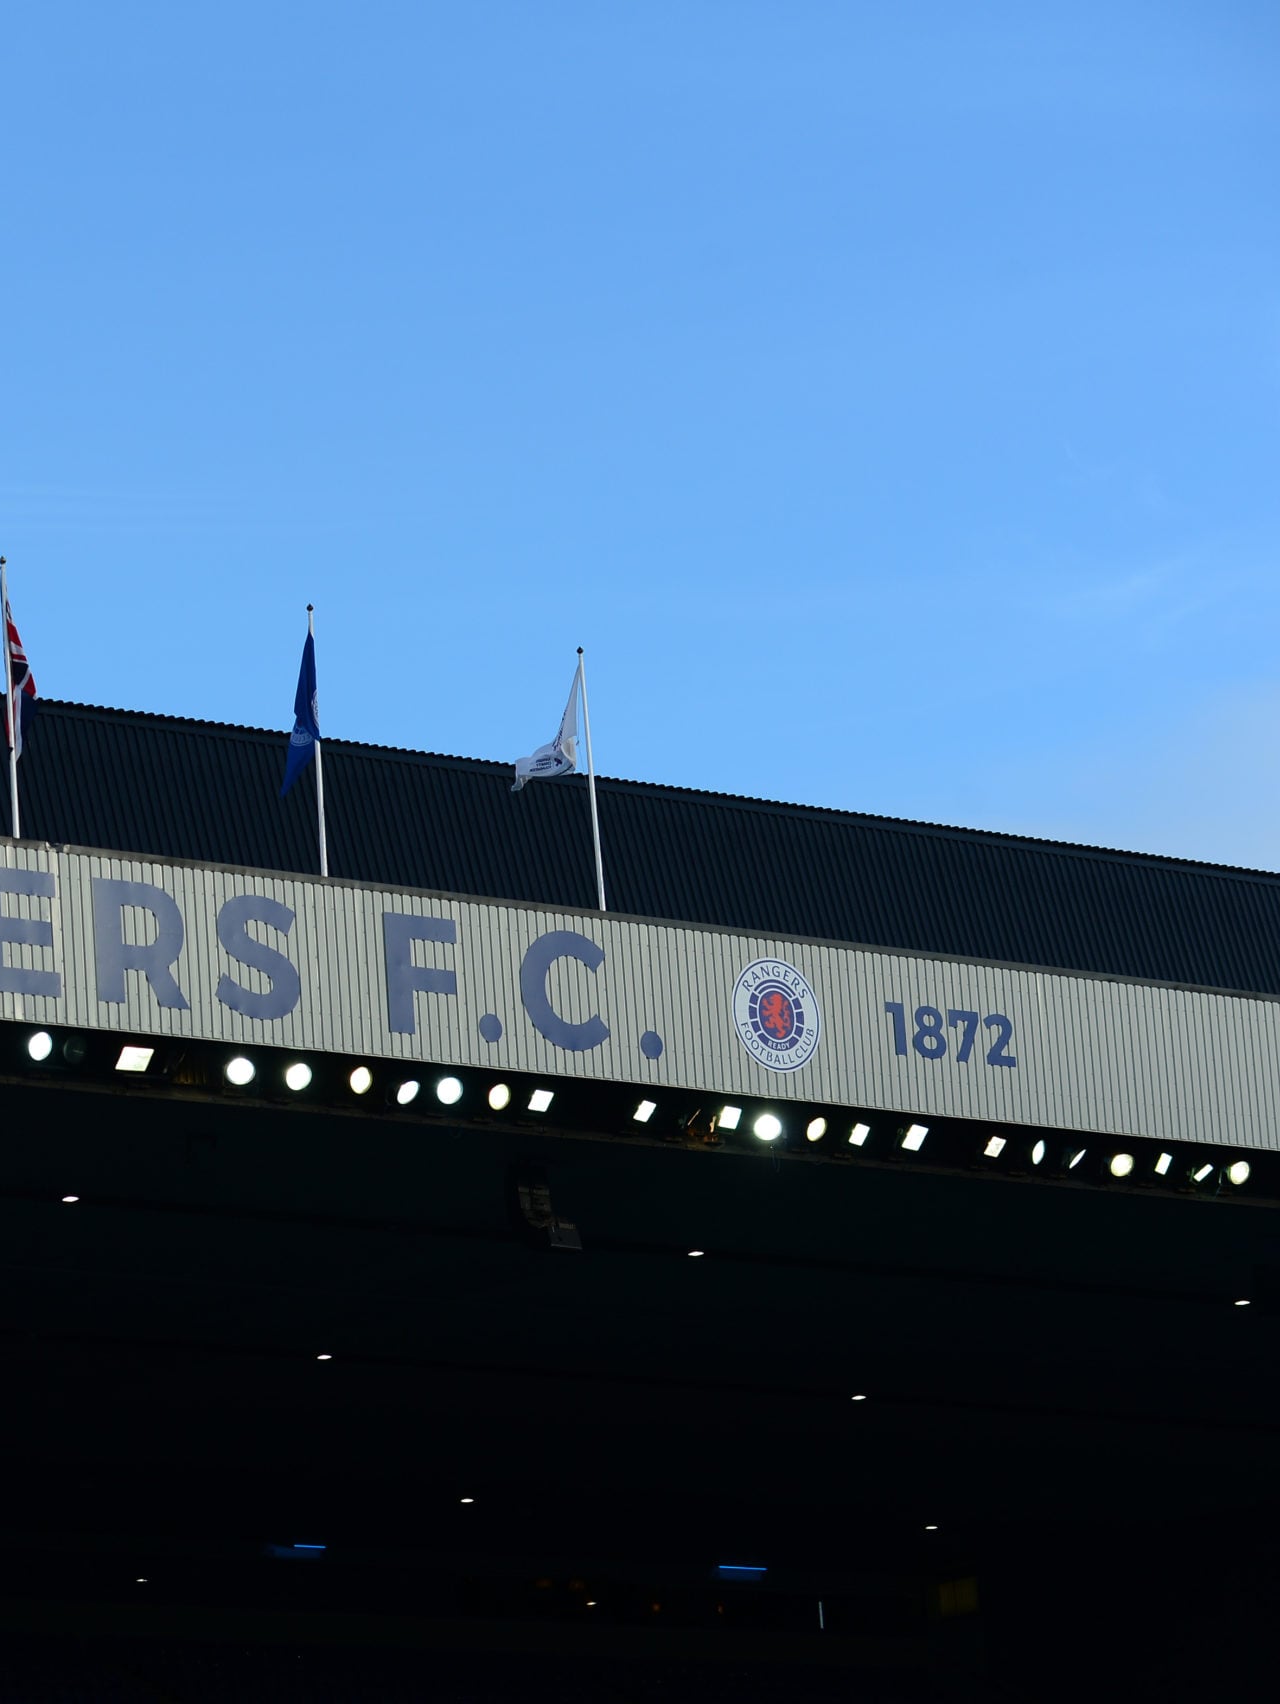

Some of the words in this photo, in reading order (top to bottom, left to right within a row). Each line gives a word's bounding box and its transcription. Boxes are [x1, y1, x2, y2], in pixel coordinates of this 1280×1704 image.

[383, 912, 663, 1060] F.C.
[742, 965, 808, 999] RANGERS
[740, 1021, 795, 1065] FOOTBALL
[795, 1028, 814, 1059] CLUB
[767, 1040, 791, 1051] READY
[884, 1001, 1017, 1068] 1872
